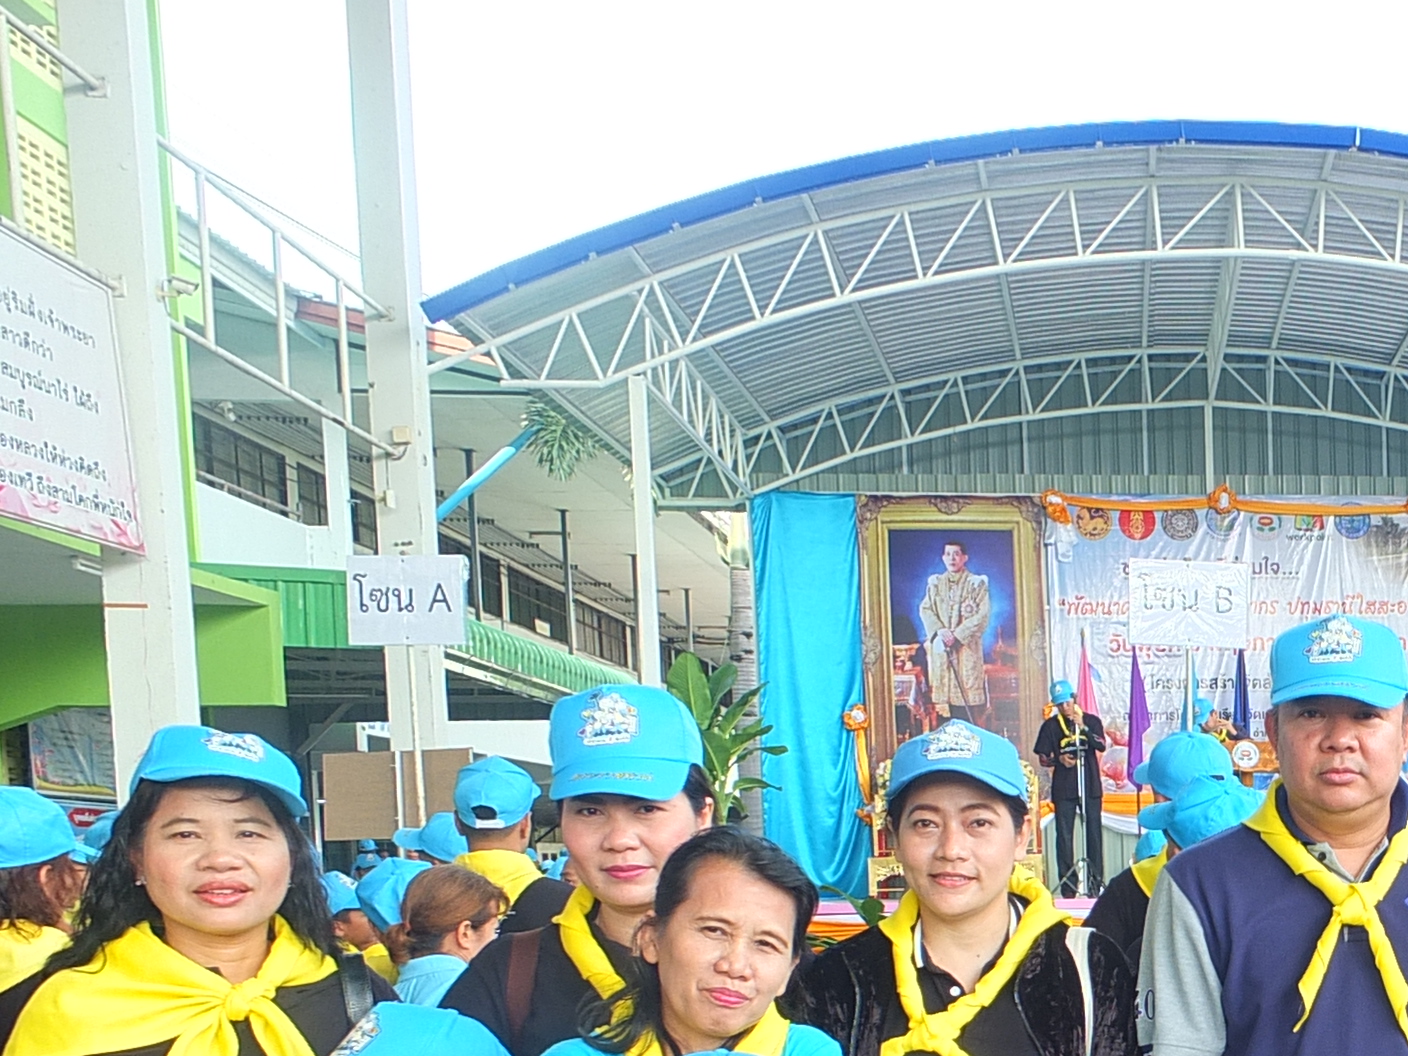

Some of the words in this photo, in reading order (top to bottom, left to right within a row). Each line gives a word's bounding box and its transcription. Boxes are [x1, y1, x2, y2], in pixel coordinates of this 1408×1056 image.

[0, 286, 96, 349] ยู่ริมฝั่งเจ้าพระยา
[352, 573, 415, 613] โซน
[428, 582, 452, 613] A
[1216, 585, 1233, 613] B
